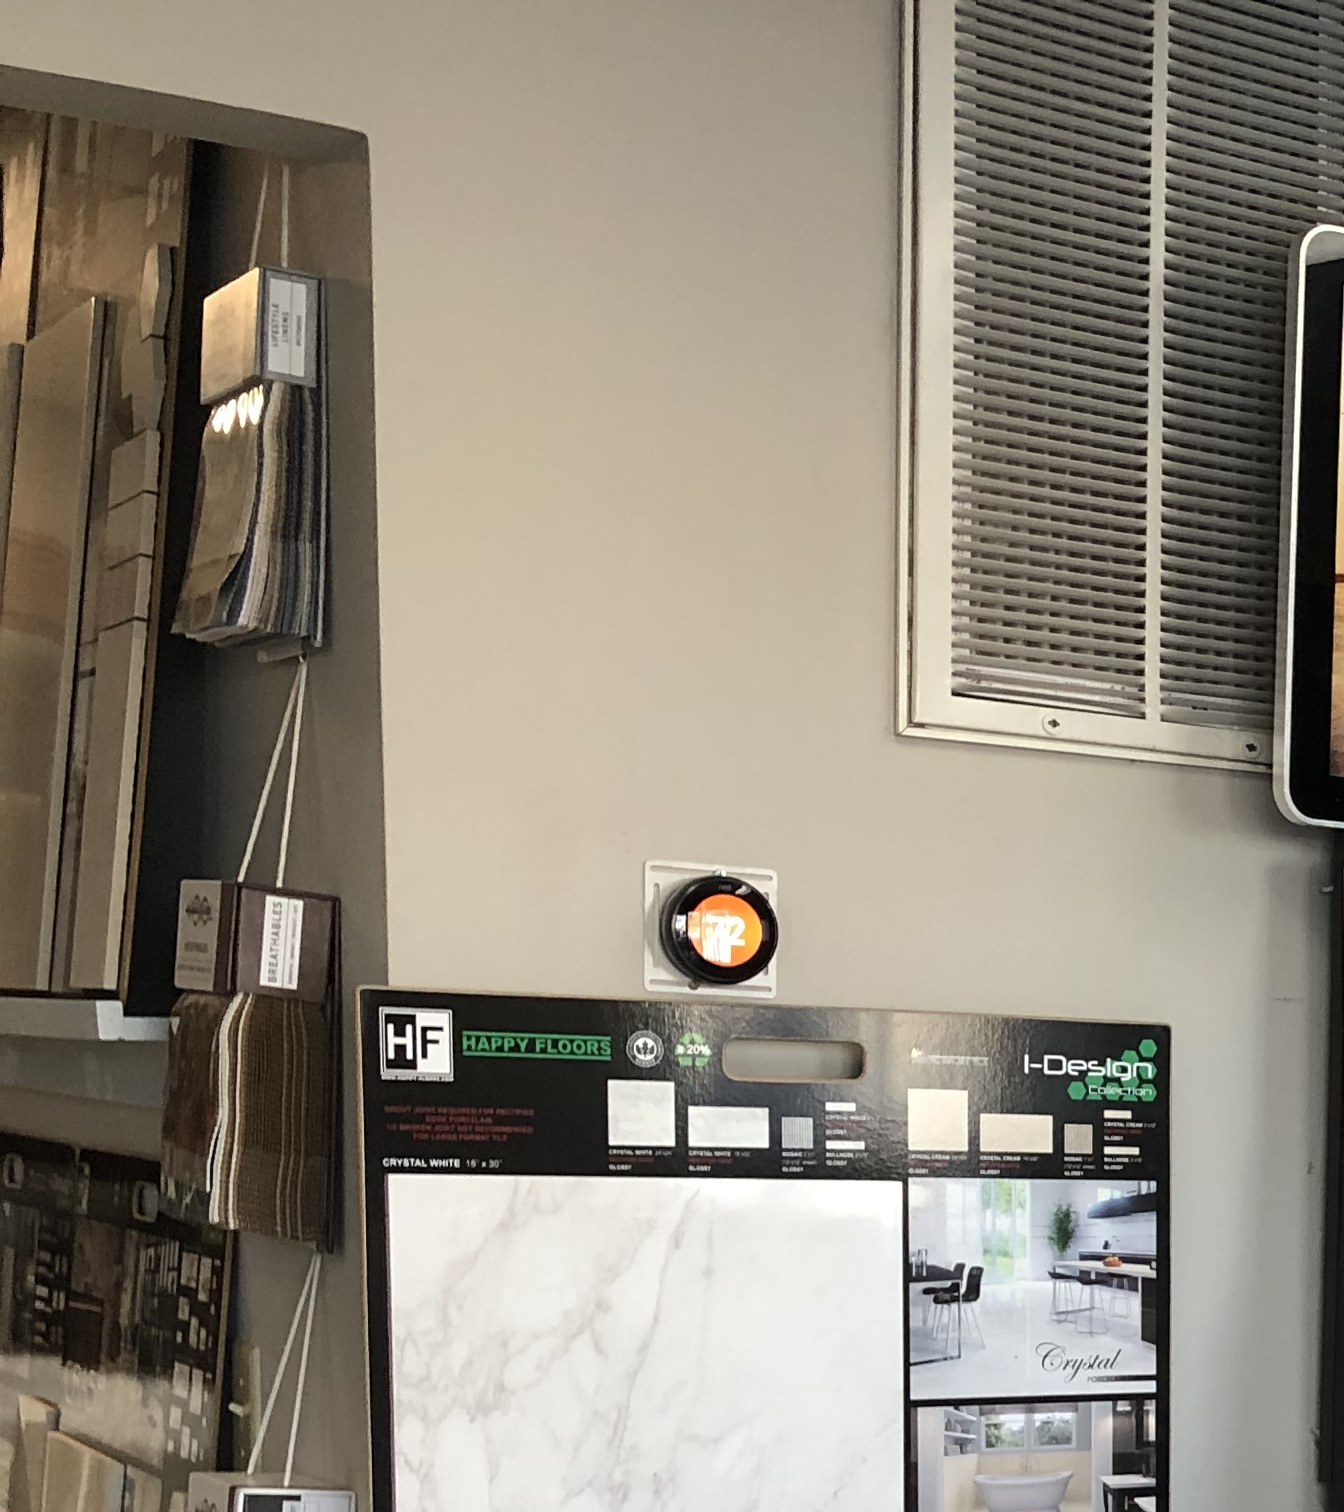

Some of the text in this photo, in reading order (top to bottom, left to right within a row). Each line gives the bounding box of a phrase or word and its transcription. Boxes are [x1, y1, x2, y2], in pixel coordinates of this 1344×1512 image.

[267, 900, 284, 984] BREATHABLES
[462, 1035, 529, 1053] HAPPY
[535, 1037, 612, 1057] FLOORS
[1024, 1052, 1152, 1081] I-Design
[1088, 1083, 1153, 1097] Collection
[382, 1157, 461, 1169] CRYSTAL WHITE
[1035, 1341, 1122, 1384] Crystal
